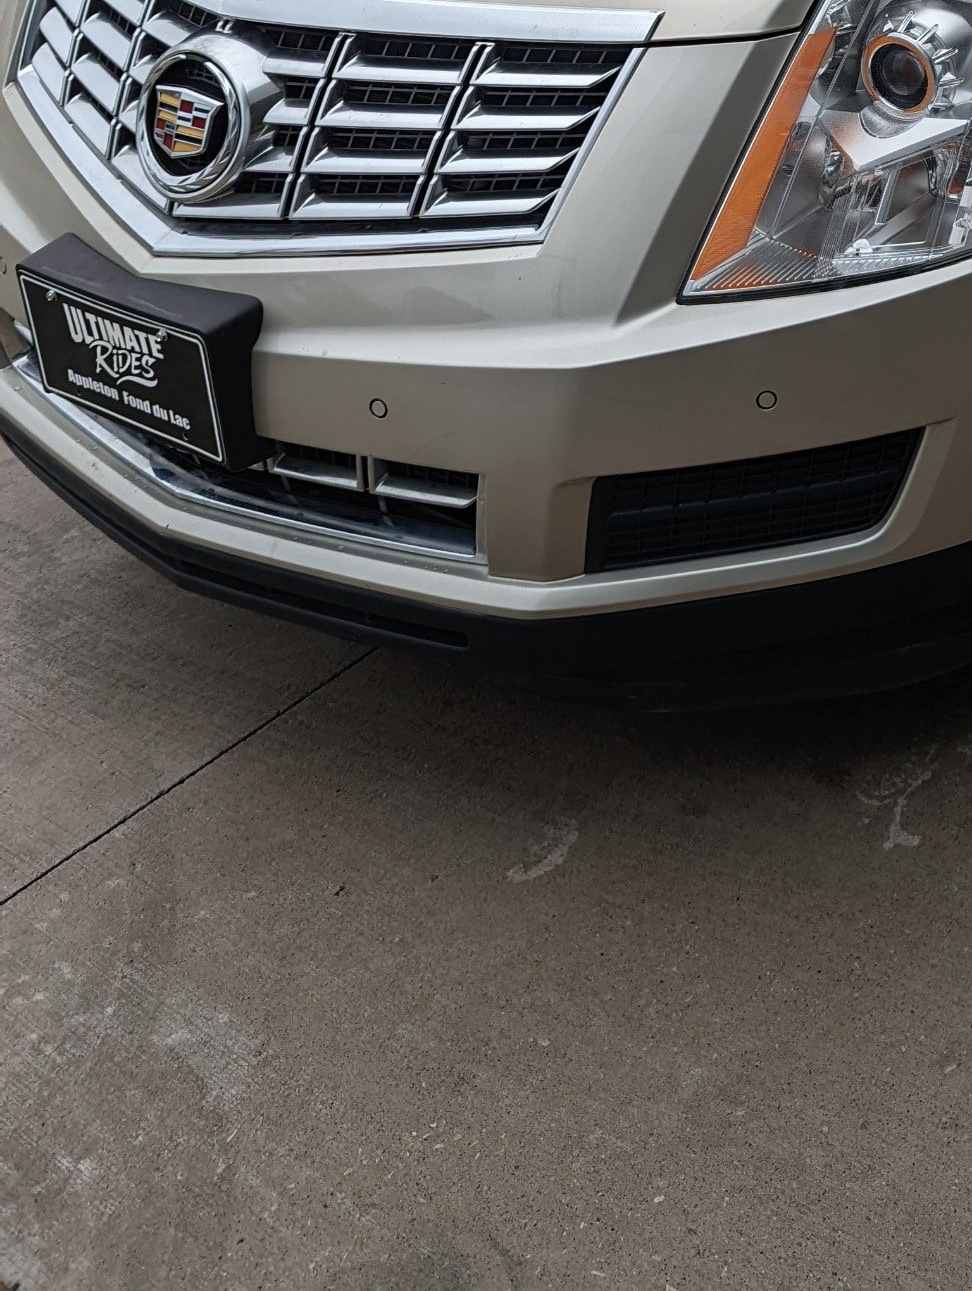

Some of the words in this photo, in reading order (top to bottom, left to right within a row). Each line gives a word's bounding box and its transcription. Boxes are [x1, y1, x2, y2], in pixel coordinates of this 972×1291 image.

[63, 303, 164, 359] ULTIMATE
[68, 369, 119, 400] Appleton
[122, 391, 151, 414] Fond
[152, 404, 168, 420] du
[169, 410, 191, 430] Lac
